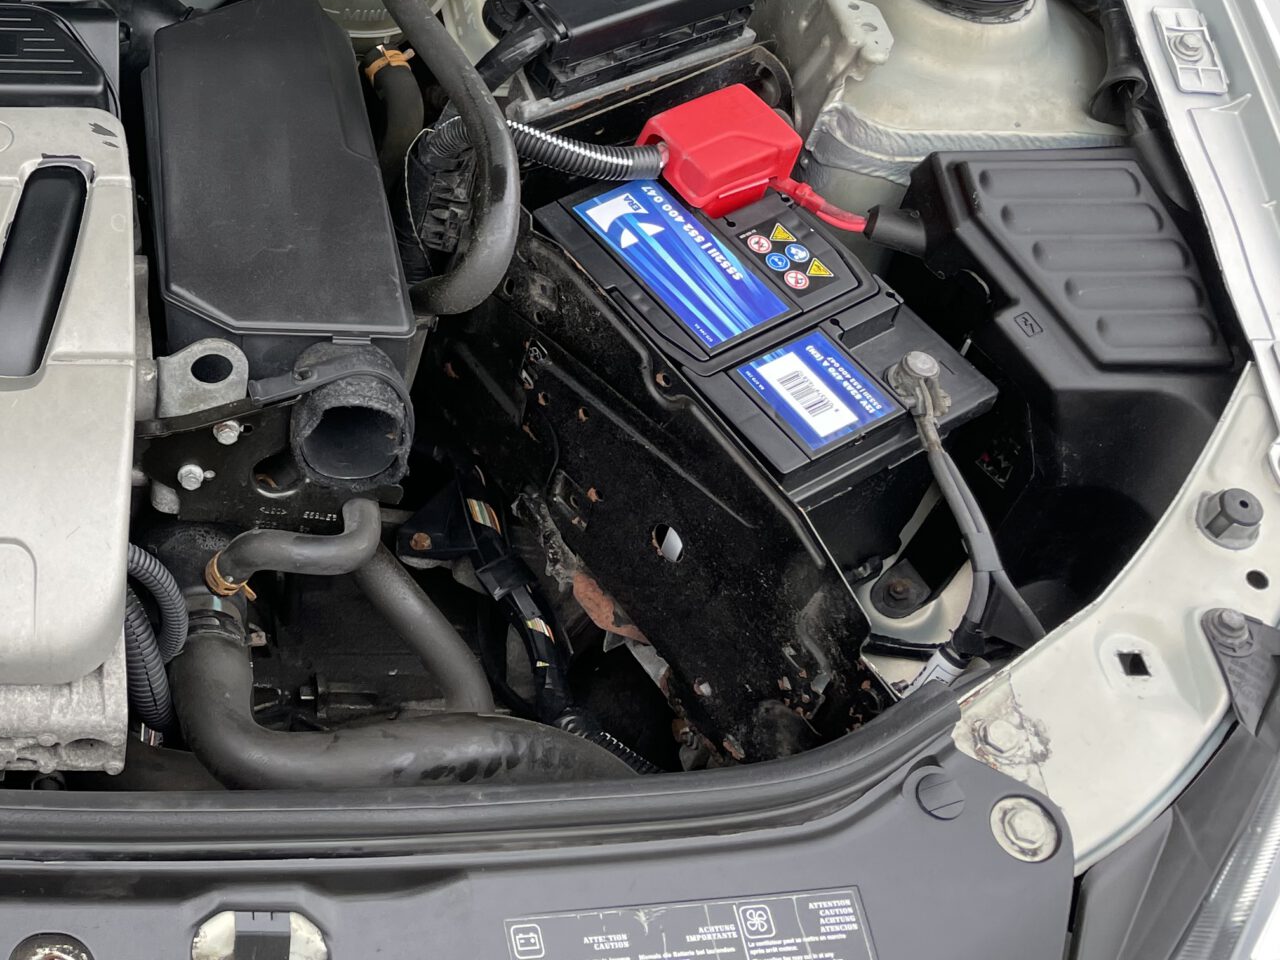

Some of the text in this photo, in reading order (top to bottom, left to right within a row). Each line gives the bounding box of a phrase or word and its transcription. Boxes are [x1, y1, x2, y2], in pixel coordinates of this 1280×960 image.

[640, 181, 665, 204] 047
[623, 194, 641, 211] ERA
[660, 201, 686, 225] 400
[681, 222, 706, 244] 552
[808, 899, 851, 909] ATTENTION
[819, 907, 854, 916] CAUTION
[820, 915, 856, 925] ACHTUNG
[698, 924, 735, 933] ACHTUNG
[593, 940, 629, 950] CAUTION
